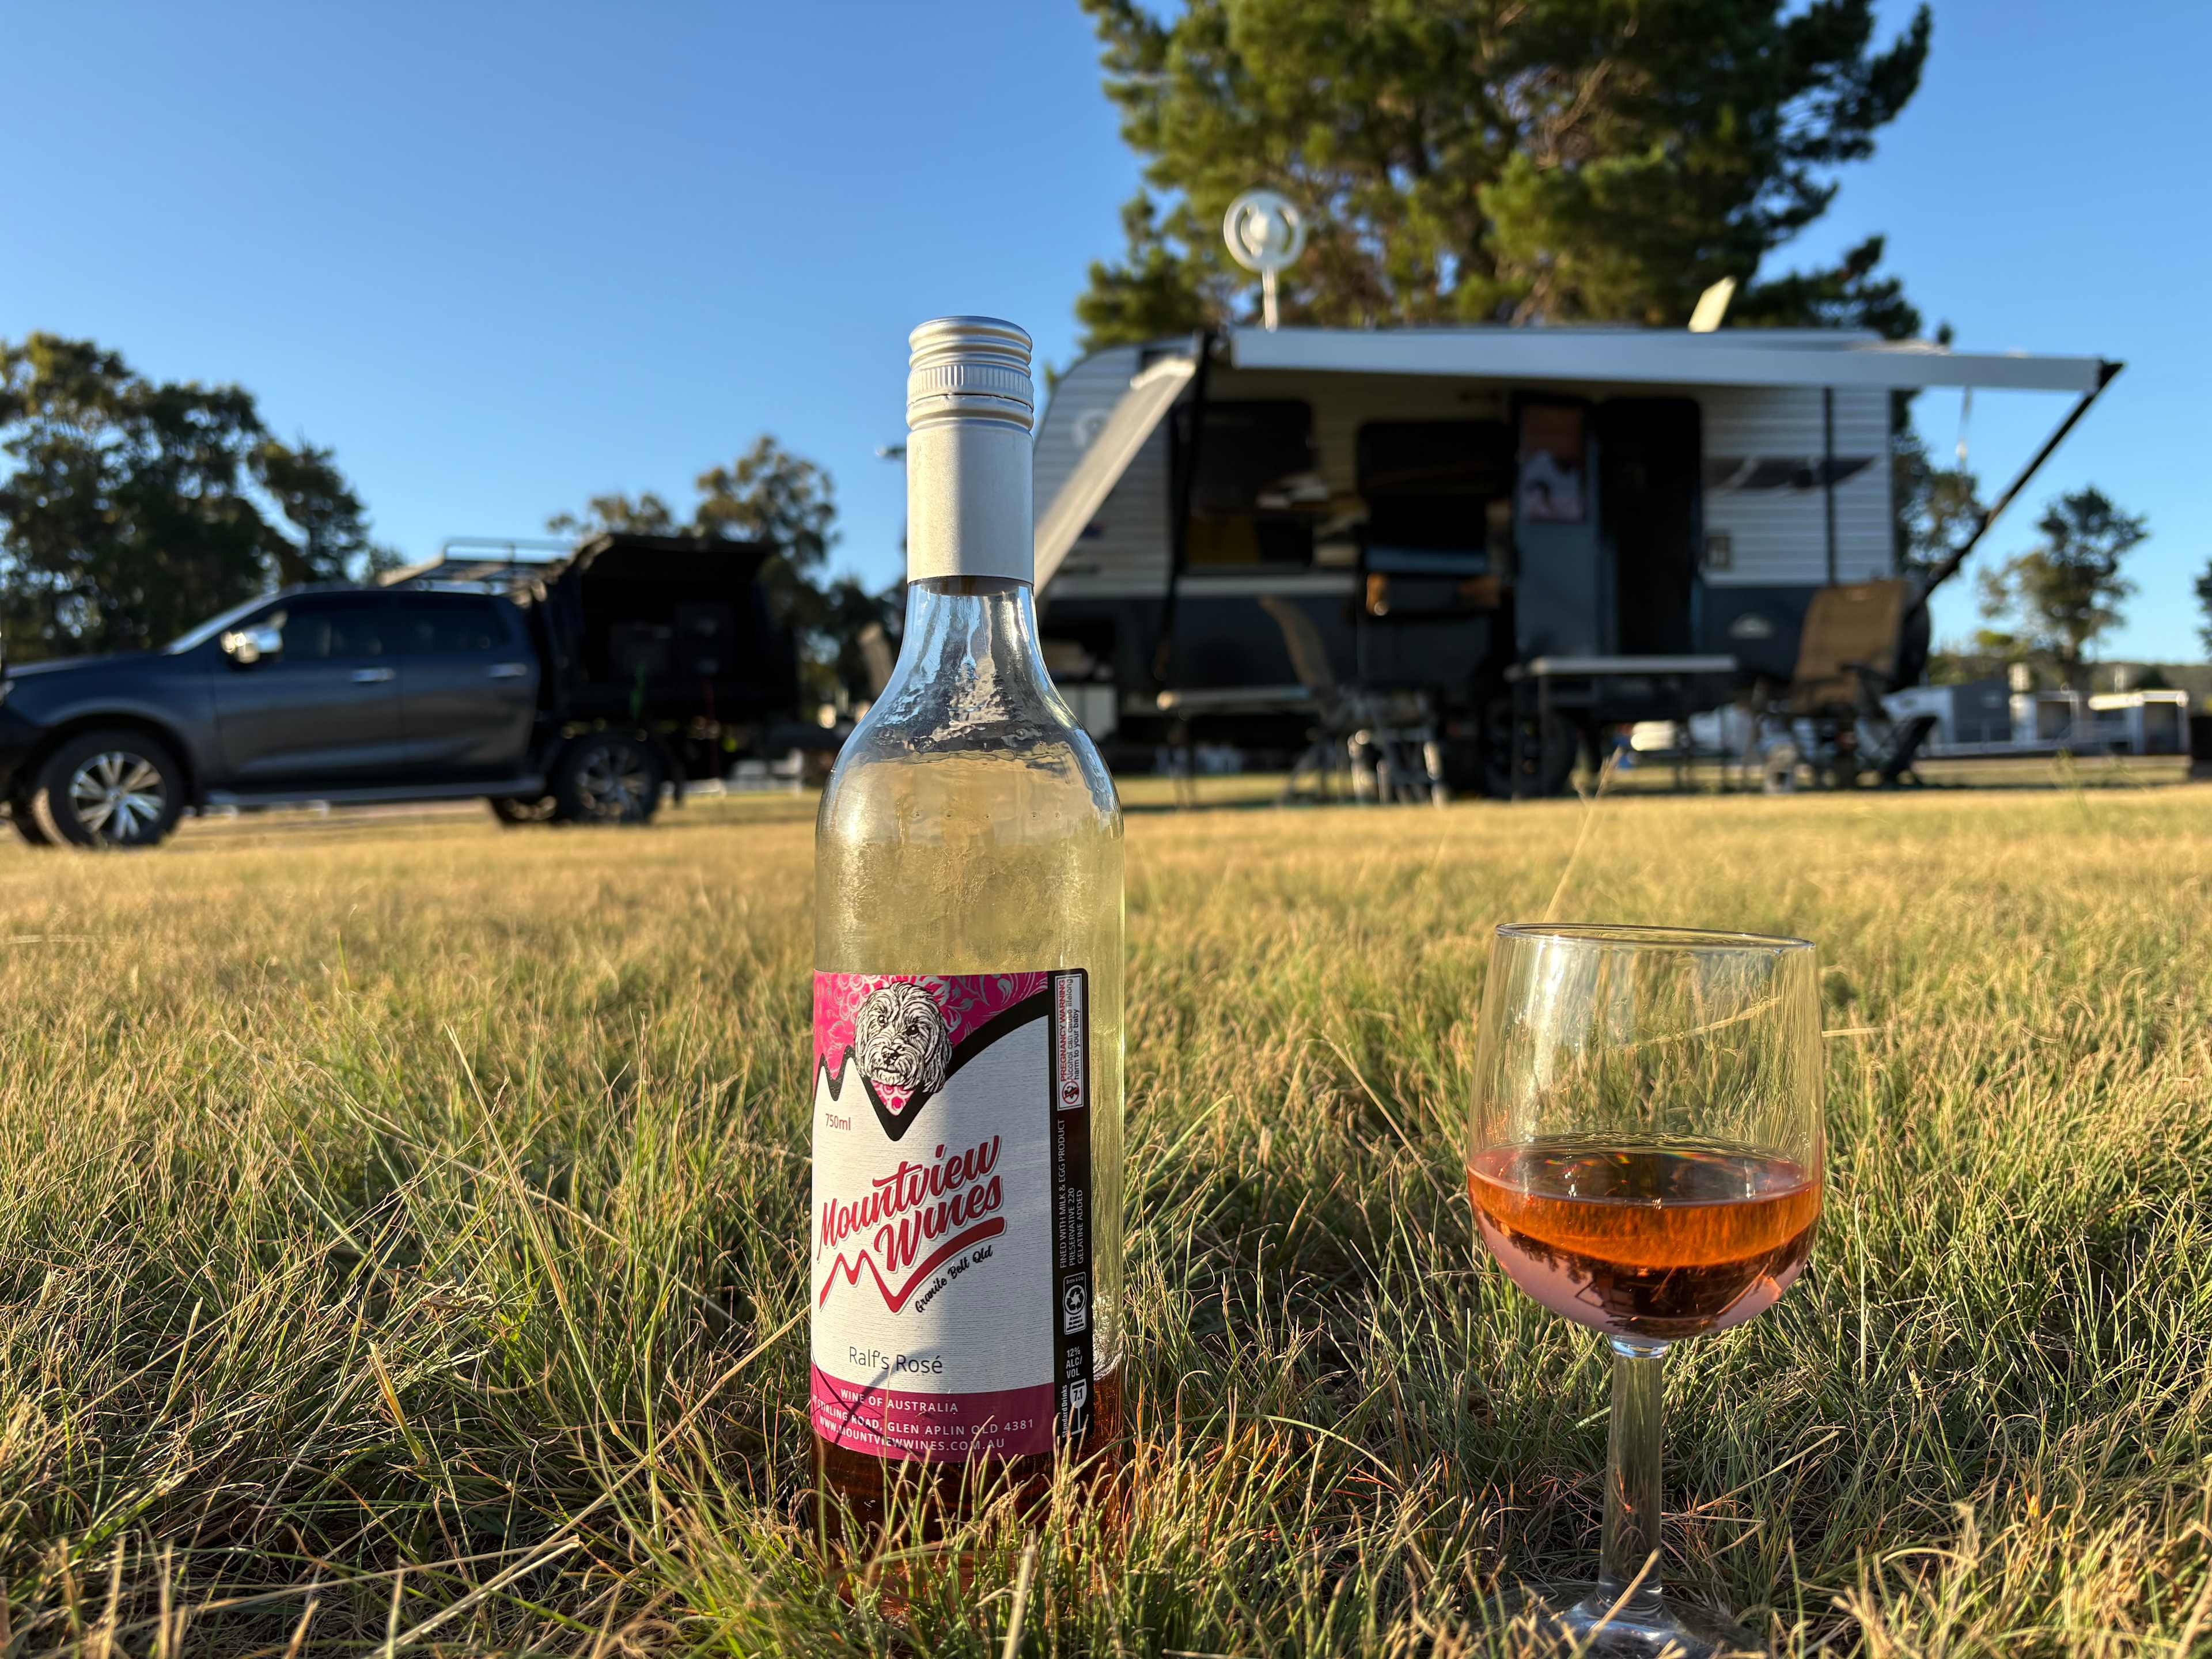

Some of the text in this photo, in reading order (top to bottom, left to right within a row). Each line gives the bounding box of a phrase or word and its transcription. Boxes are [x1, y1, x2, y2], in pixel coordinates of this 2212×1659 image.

[1074, 1050, 1080, 1058] to
[825, 1113, 851, 1130] 750ml
[1058, 1119, 1066, 1162] PRODUCT
[817, 1135, 999, 1261] Mountview
[874, 1175, 1001, 1271] Wines
[1068, 1206, 1076, 1266] PRESERVATIVE
[915, 1245, 993, 1313] Granite Belt Qld
[850, 1346, 943, 1374] Ralf's Rosé
[1066, 1346, 1081, 1358] 12%
[1066, 1355, 1082, 1369] ALC/
[1066, 1368, 1080, 1378] VOL
[840, 1388, 959, 1412] WINE OF AUSTRALIA
[1073, 1388, 1083, 1402] 7.1
[817, 1399, 848, 1421] STIRLING
[851, 1414, 883, 1431] ROAD,
[888, 1422, 919, 1434] GLEN
[925, 1426, 964, 1435] APLIN
[1004, 1419, 1033, 1431] 4381
[819, 1415, 1005, 1450] WWW.MOUNTVIEWWINES.COM.AU
